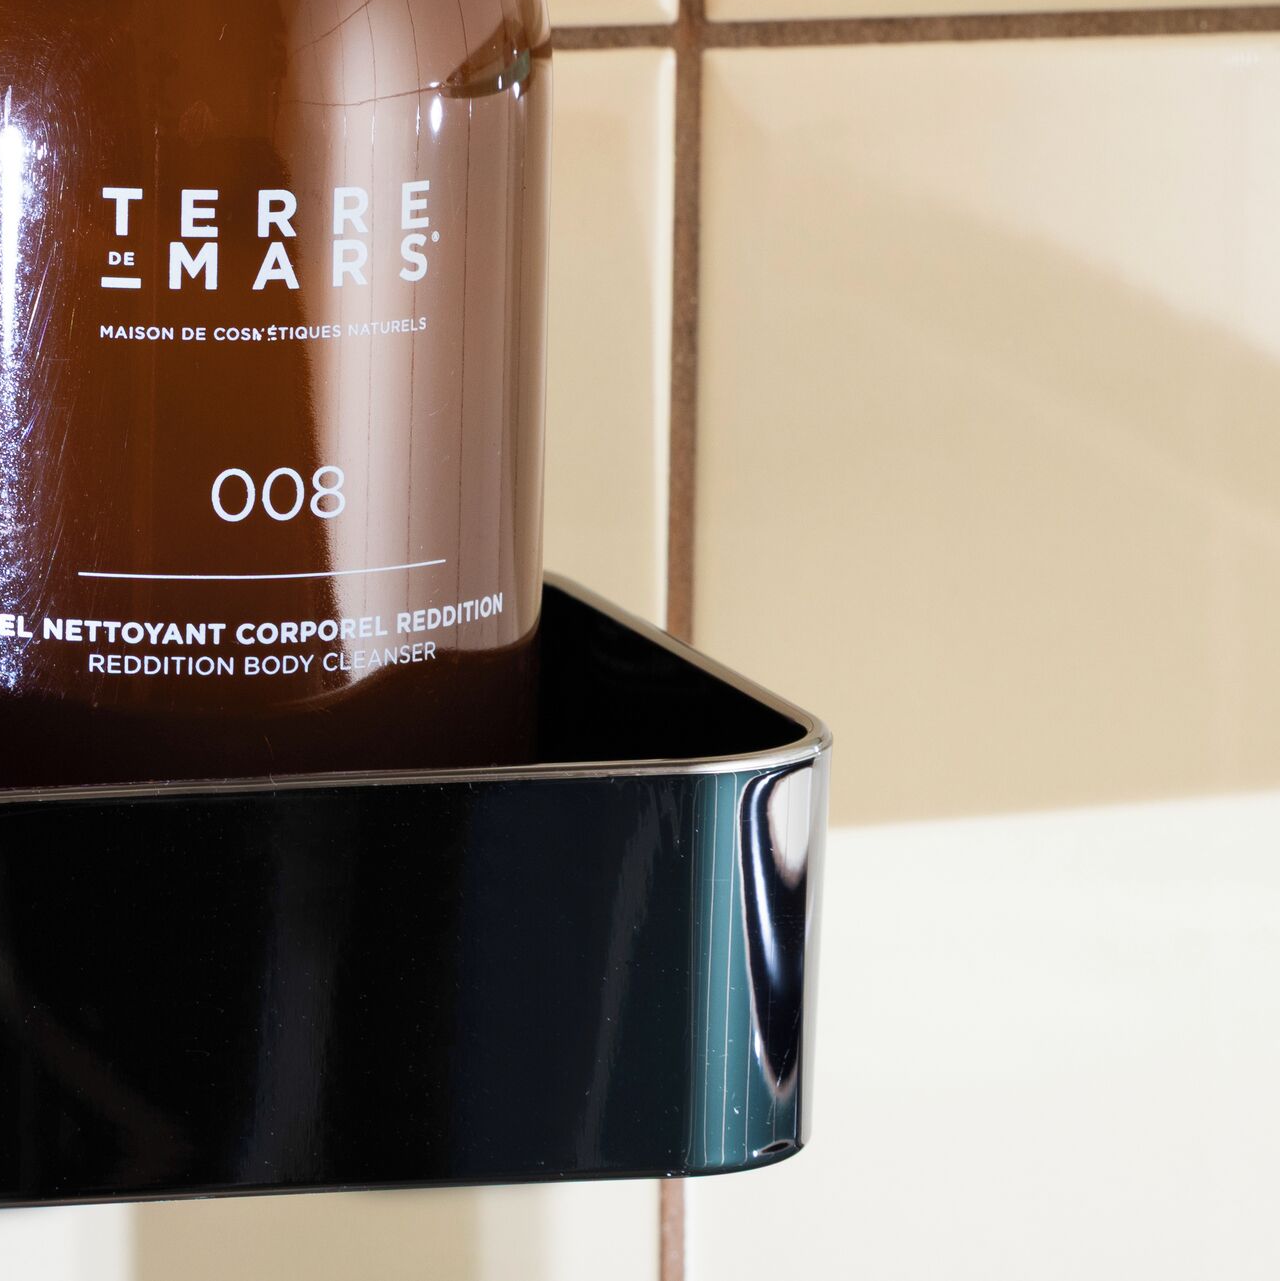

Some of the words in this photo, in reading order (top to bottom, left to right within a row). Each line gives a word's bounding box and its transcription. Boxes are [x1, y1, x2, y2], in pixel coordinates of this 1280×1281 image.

[102, 180, 431, 238] TERRE
[108, 251, 135, 267] DE
[99, 325, 174, 340] MAISON
[181, 327, 206, 341] DE
[347, 317, 427, 337] NATURELS
[211, 466, 347, 522] 008
[43, 617, 226, 645] NETTOYANT
[235, 614, 388, 645] CORPOREL
[396, 592, 504, 635] REDDITION
[89, 653, 235, 676] REDDITION
[244, 654, 315, 676] BODY
[322, 641, 437, 672] CLEANSER
